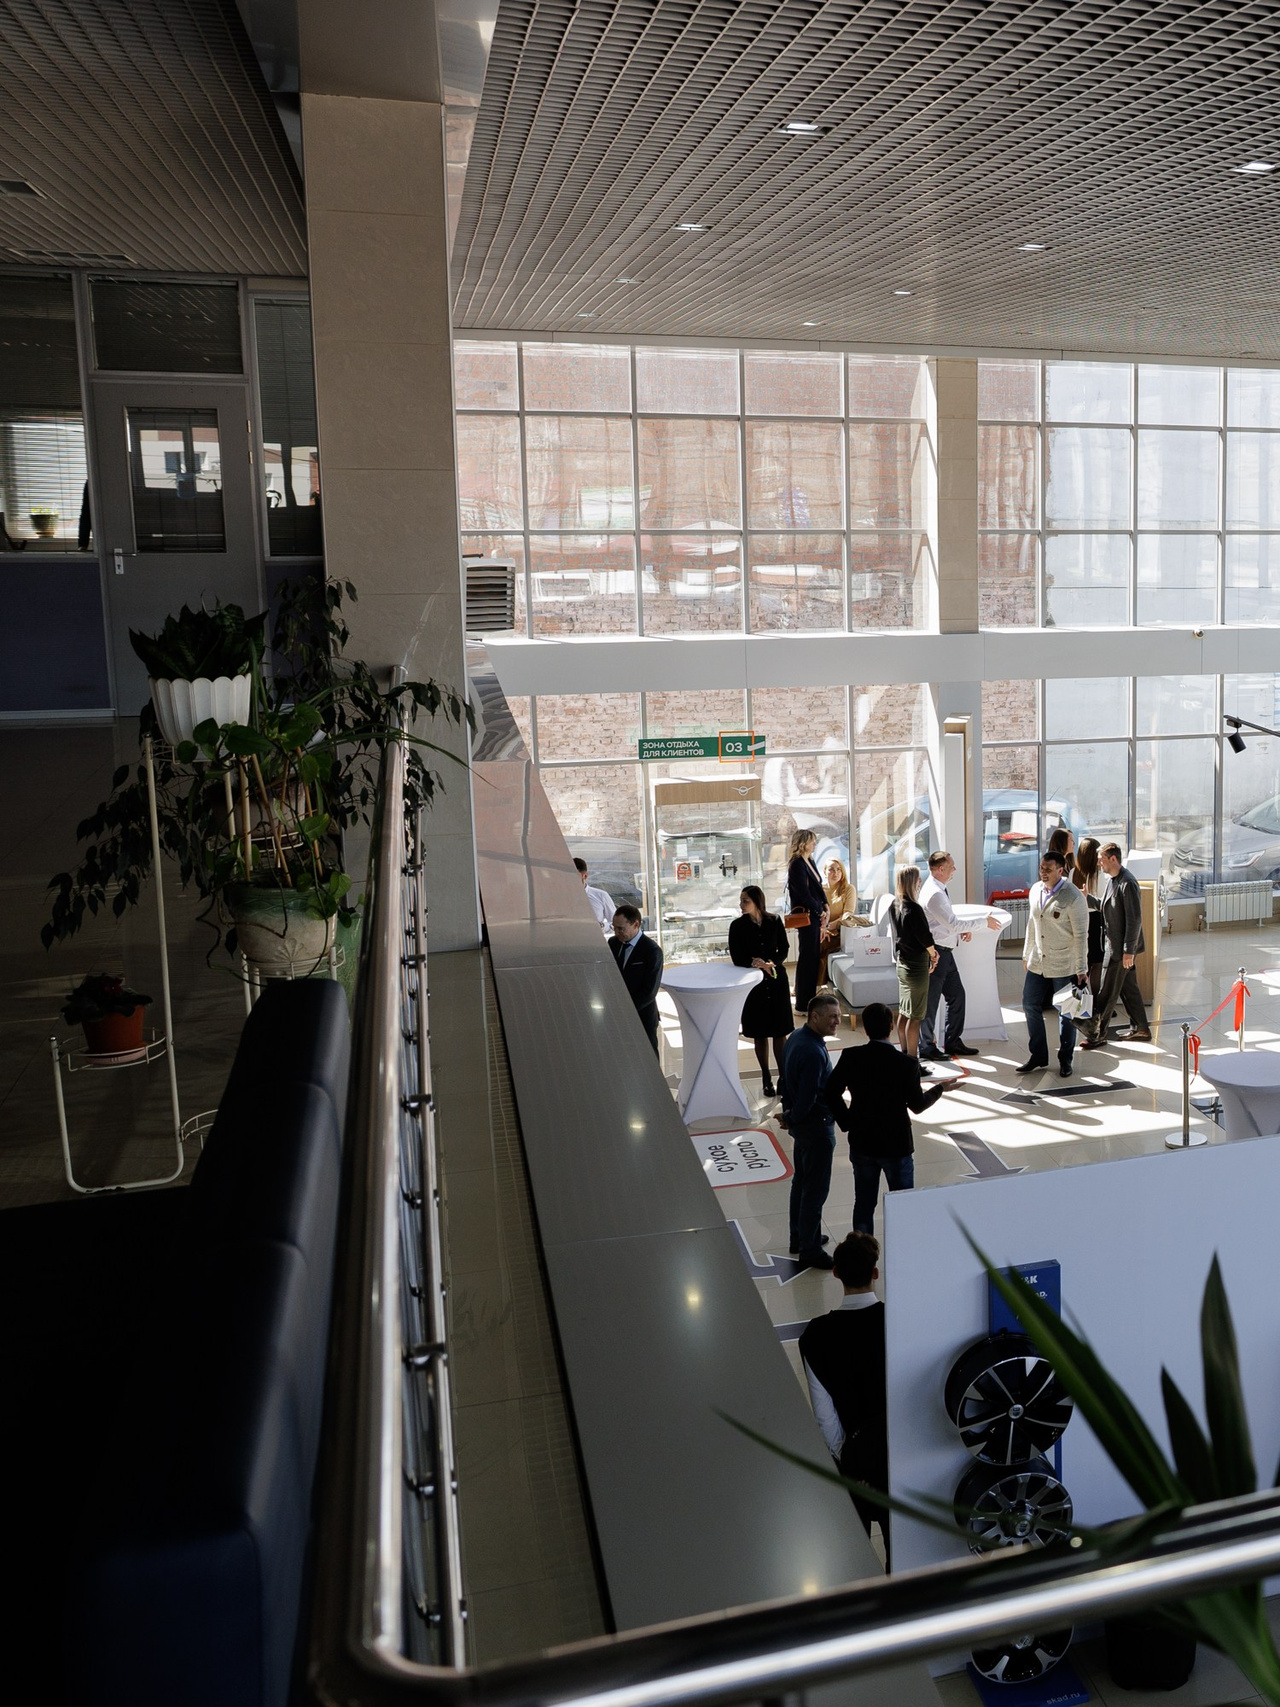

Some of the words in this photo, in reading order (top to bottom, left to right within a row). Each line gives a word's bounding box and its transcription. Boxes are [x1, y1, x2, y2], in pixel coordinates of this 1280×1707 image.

[642, 741, 666, 749] ЗОНА
[666, 740, 700, 749] ОТДЫХА
[725, 742, 743, 753] 03
[642, 749, 660, 758] ДЛЯ
[661, 748, 705, 757] КЛИЕНТОВ
[708, 1144, 739, 1173] сухое
[737, 1141, 771, 1170] русло
[1046, 1692, 1081, 1705] skad.ru
